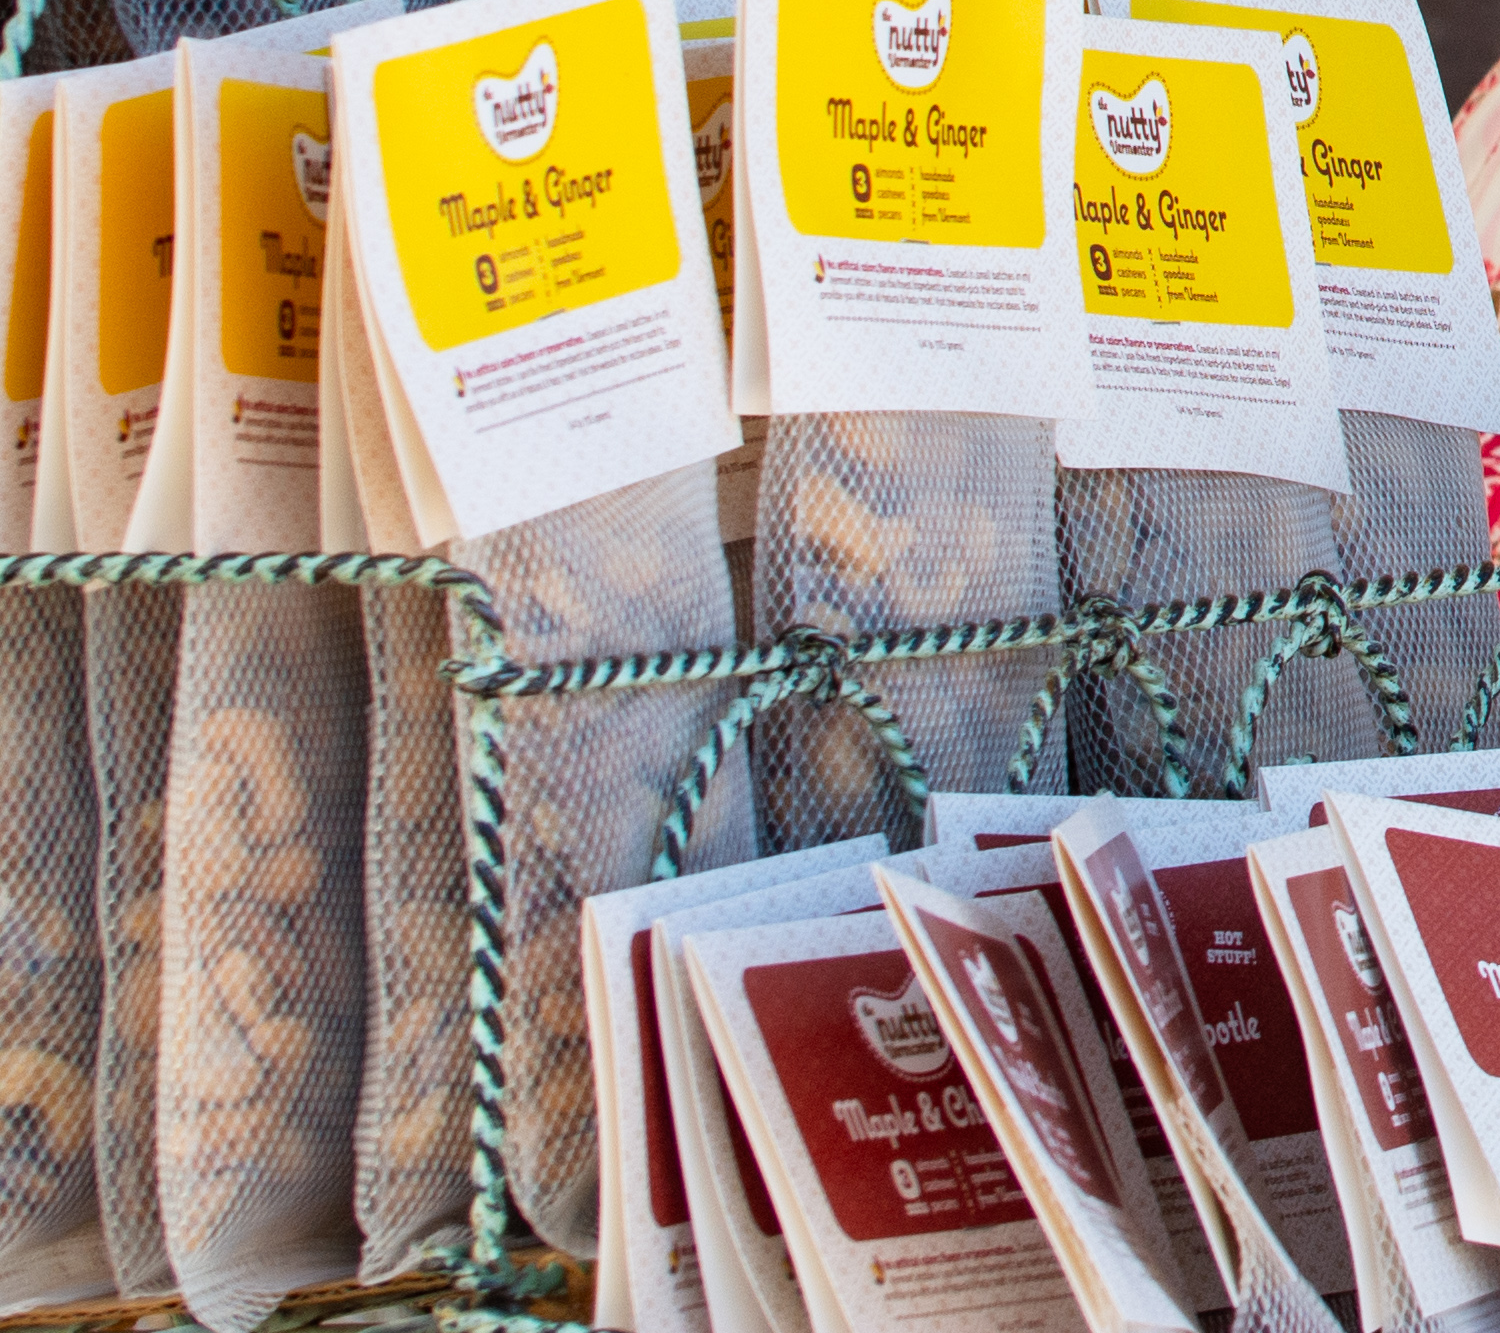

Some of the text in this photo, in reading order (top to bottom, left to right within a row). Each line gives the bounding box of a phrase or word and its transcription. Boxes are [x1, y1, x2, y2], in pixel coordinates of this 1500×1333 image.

[827, 98, 987, 158] Maple & Ginger
[1136, 190, 1226, 242] & Ginger
